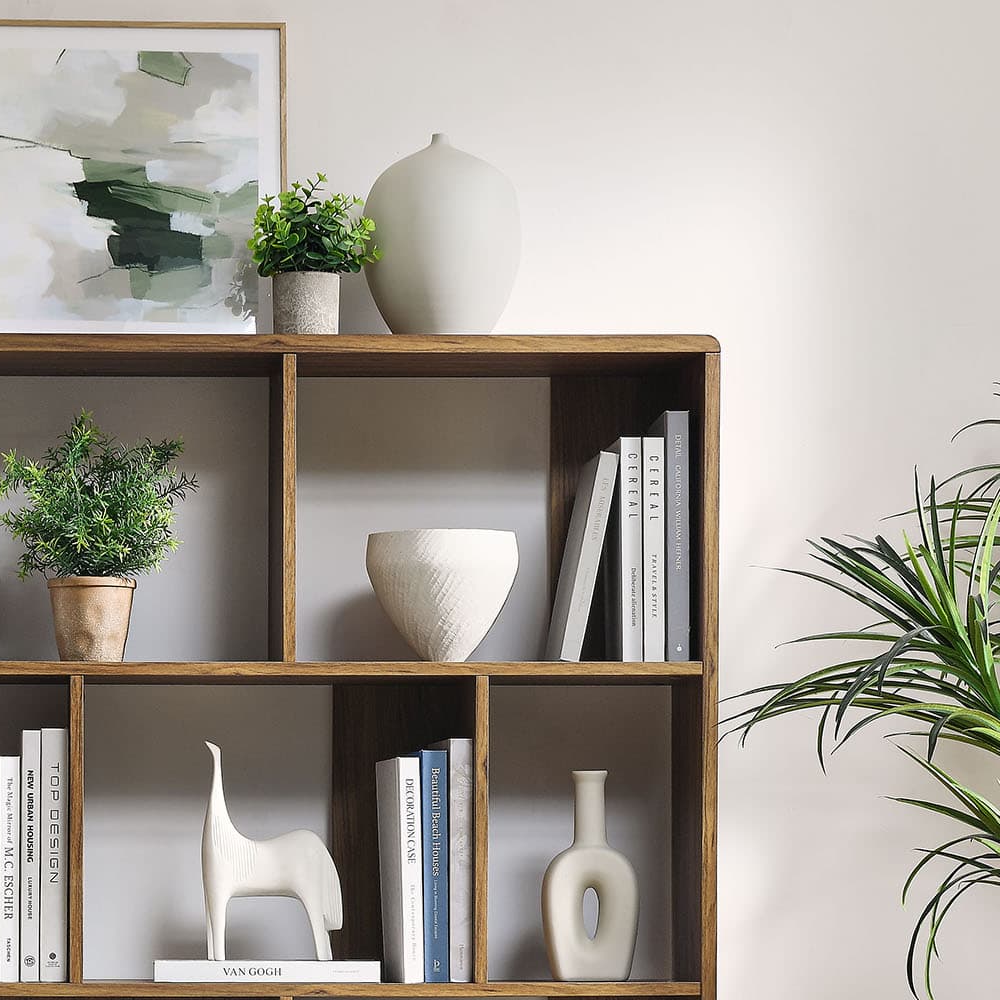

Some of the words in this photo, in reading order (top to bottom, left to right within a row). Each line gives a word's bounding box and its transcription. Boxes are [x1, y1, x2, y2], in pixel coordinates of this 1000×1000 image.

[674, 434, 682, 458] DETAIL
[628, 453, 639, 518] CEREAL
[649, 455, 660, 521] CEREAL
[674, 464, 682, 508] CALIFORNIA
[674, 510, 682, 542] WILLIAM
[6, 777, 14, 790] The
[26, 769, 34, 789] NEW
[50, 762, 60, 801] TOP
[431, 767, 441, 810] Beautiful
[5, 791, 14, 812] Magic
[26, 792, 34, 822] URBAN
[405, 778, 416, 838] DECORATION
[6, 836, 14, 844] of
[431, 812, 441, 840] Beach
[4, 847, 14, 872] M.C.
[26, 825, 34, 863] HOUSING
[49, 809, 60, 884] DESIGN
[407, 840, 417, 865] CASE
[432, 842, 441, 876] Houses
[3, 875, 14, 920] ESCHER
[223, 967, 246, 976] VAN
[248, 967, 282, 976] GOGH
